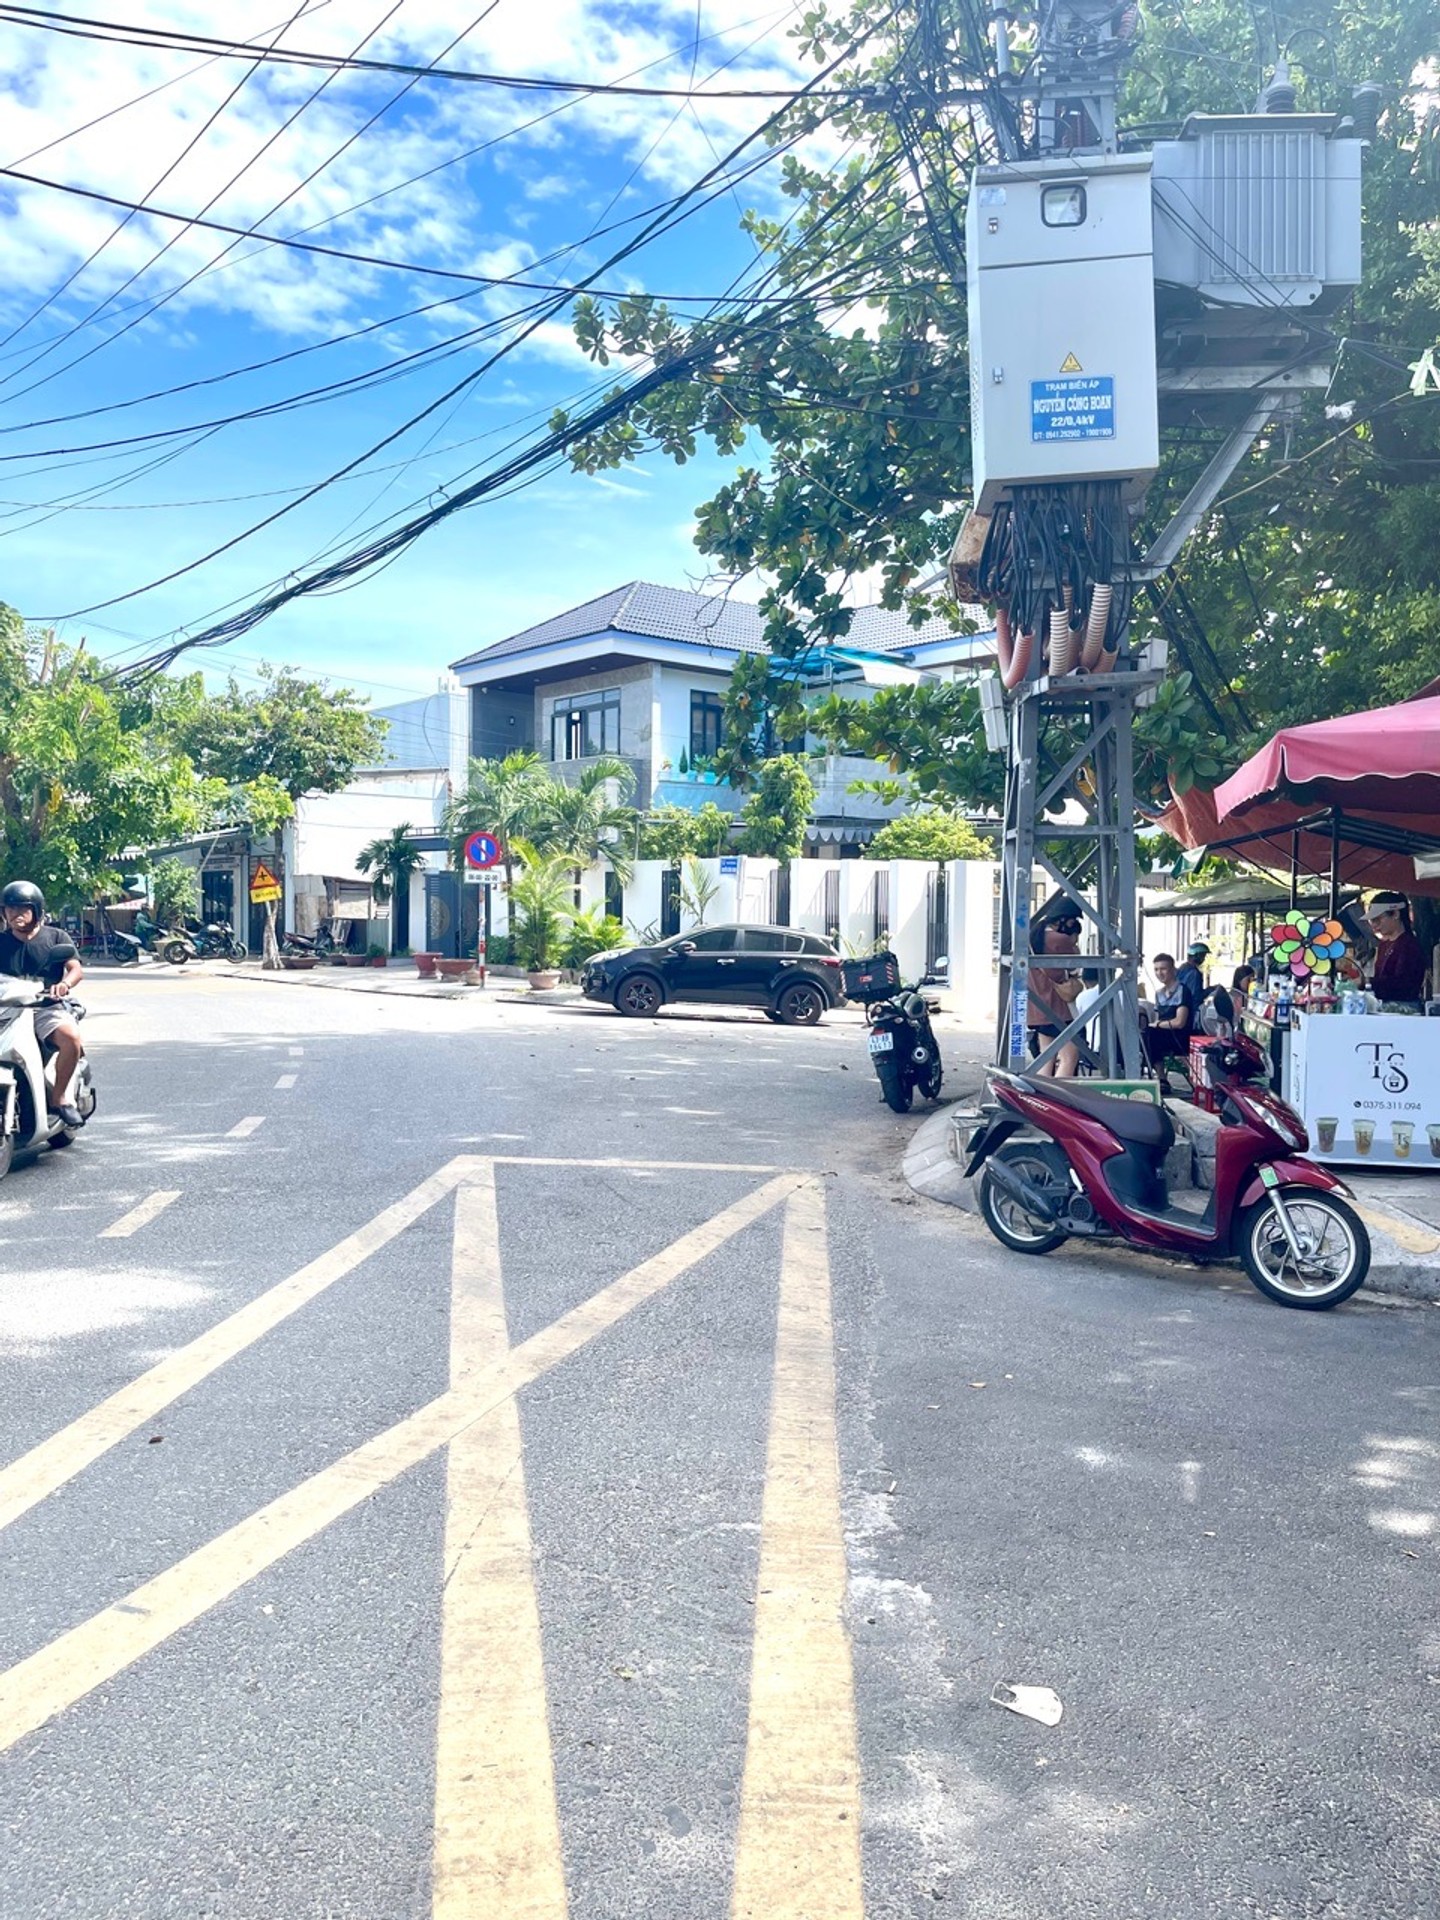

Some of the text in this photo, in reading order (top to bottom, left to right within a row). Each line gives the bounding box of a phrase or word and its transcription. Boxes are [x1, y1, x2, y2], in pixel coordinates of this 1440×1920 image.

[1045, 382, 1067, 392] TRẠM
[1089, 379, 1100, 389] ÁP
[1363, 1101, 1422, 1110] 0375.311.094
